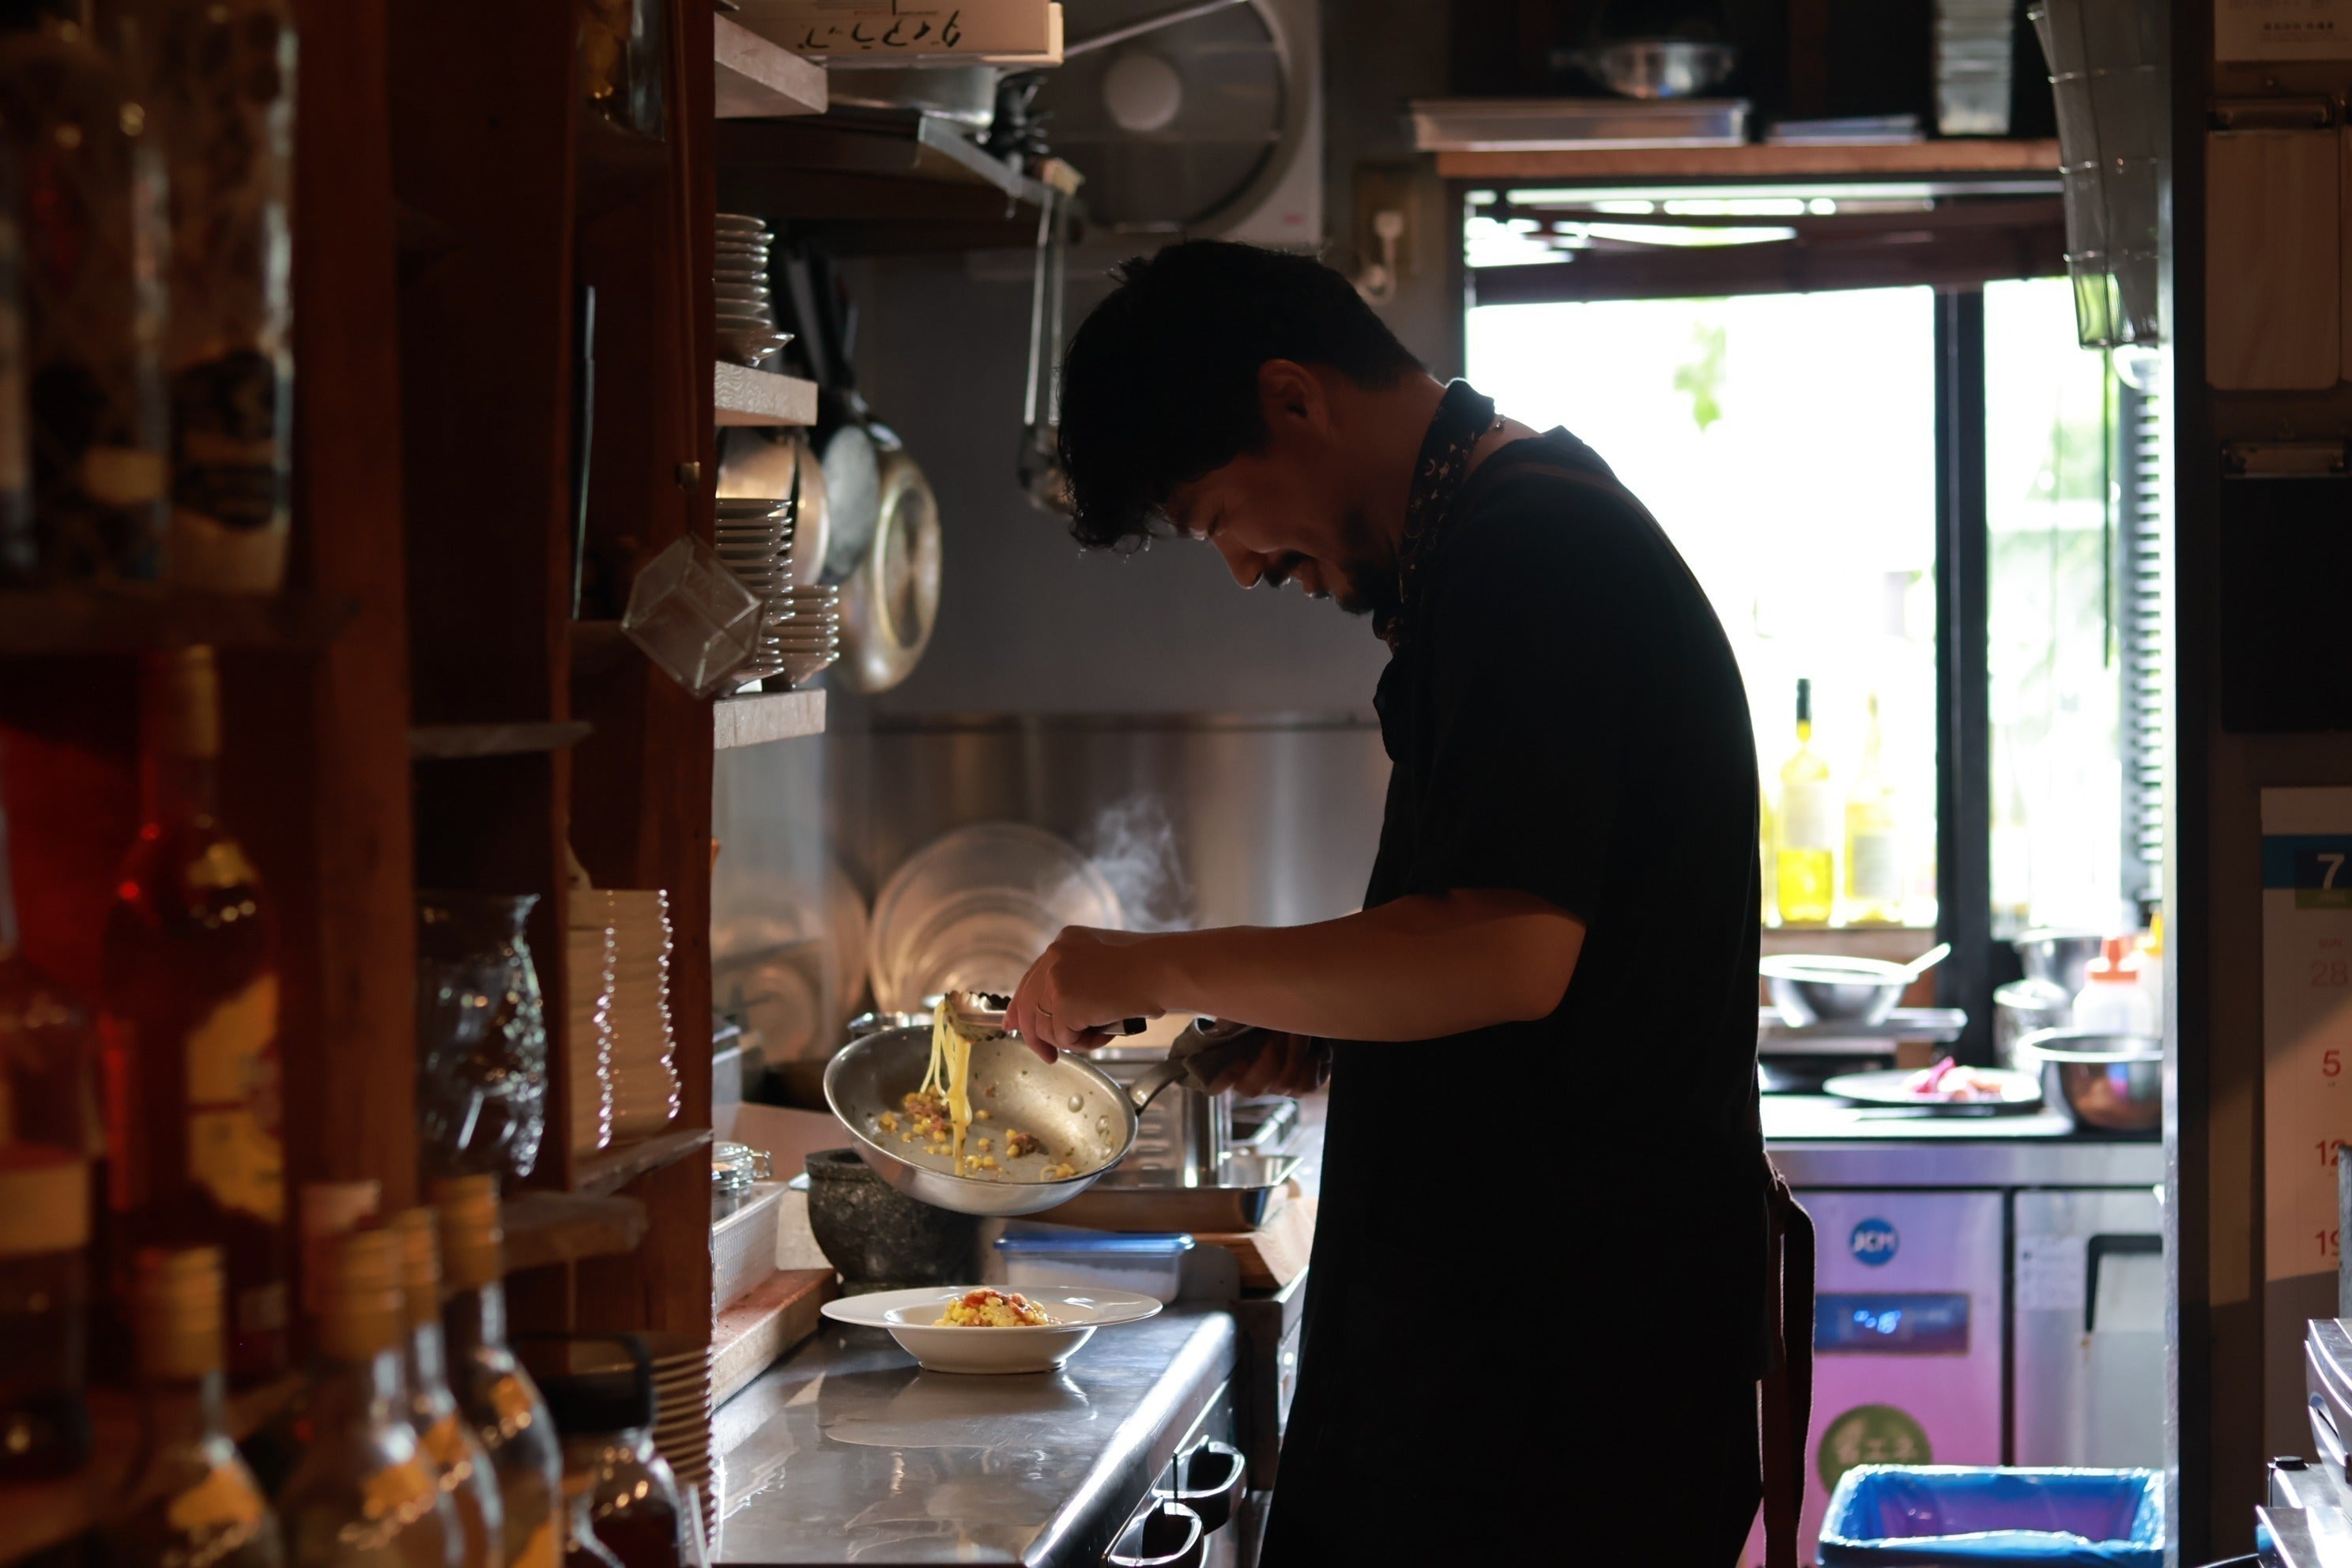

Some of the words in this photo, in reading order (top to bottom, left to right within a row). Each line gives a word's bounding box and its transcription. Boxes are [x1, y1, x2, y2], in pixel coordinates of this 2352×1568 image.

[2316, 853, 2346, 891] 7
[2310, 959, 2348, 986] 28
[2322, 1050, 2342, 1077] 5
[1852, 1229, 1896, 1253] JCM
